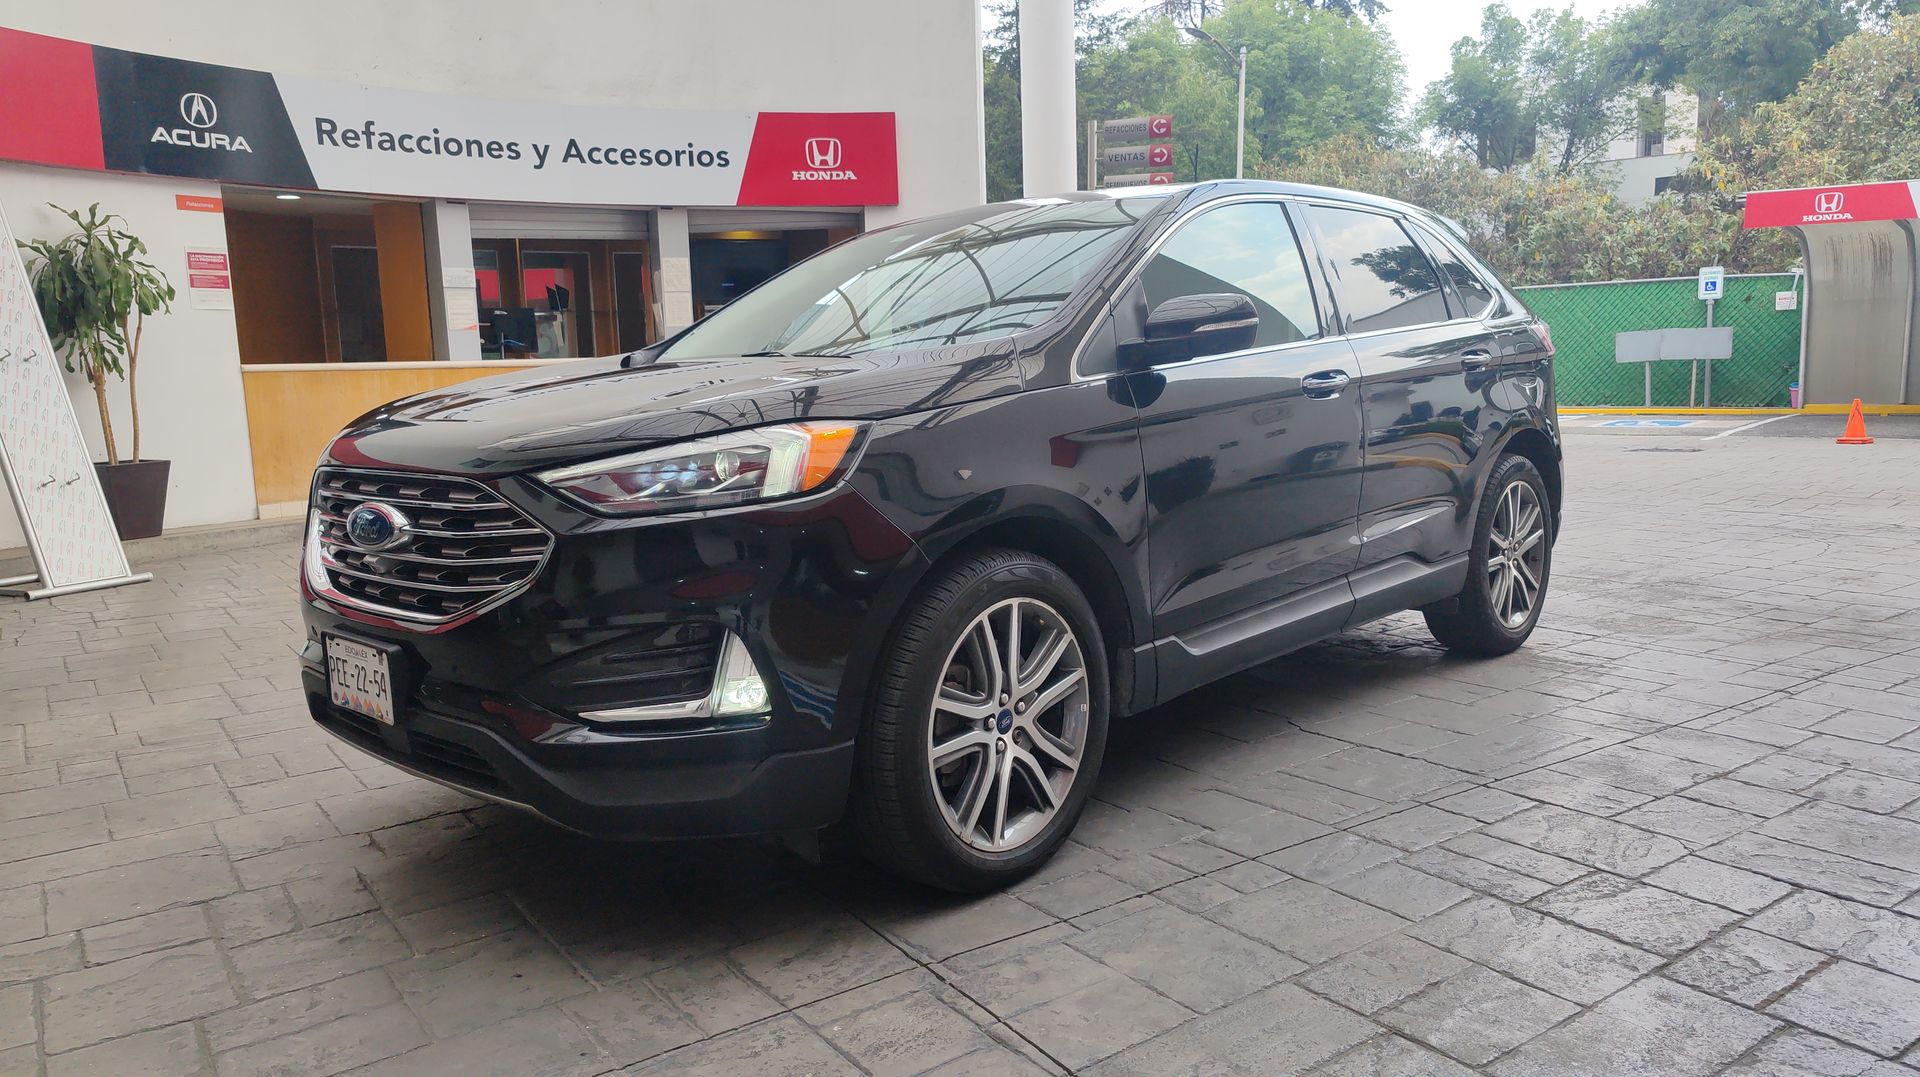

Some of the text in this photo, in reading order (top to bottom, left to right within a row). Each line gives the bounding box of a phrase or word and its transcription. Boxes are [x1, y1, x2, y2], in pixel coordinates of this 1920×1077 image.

[1104, 123, 1147, 134] REFACCIONES
[151, 127, 253, 153] ACURA
[315, 117, 730, 170] Refacciones y Accesorios
[1108, 152, 1146, 162] VENTAS
[792, 169, 858, 181] HONDA
[1802, 212, 1853, 222] HONDA
[328, 654, 389, 701] PEE-22-54
